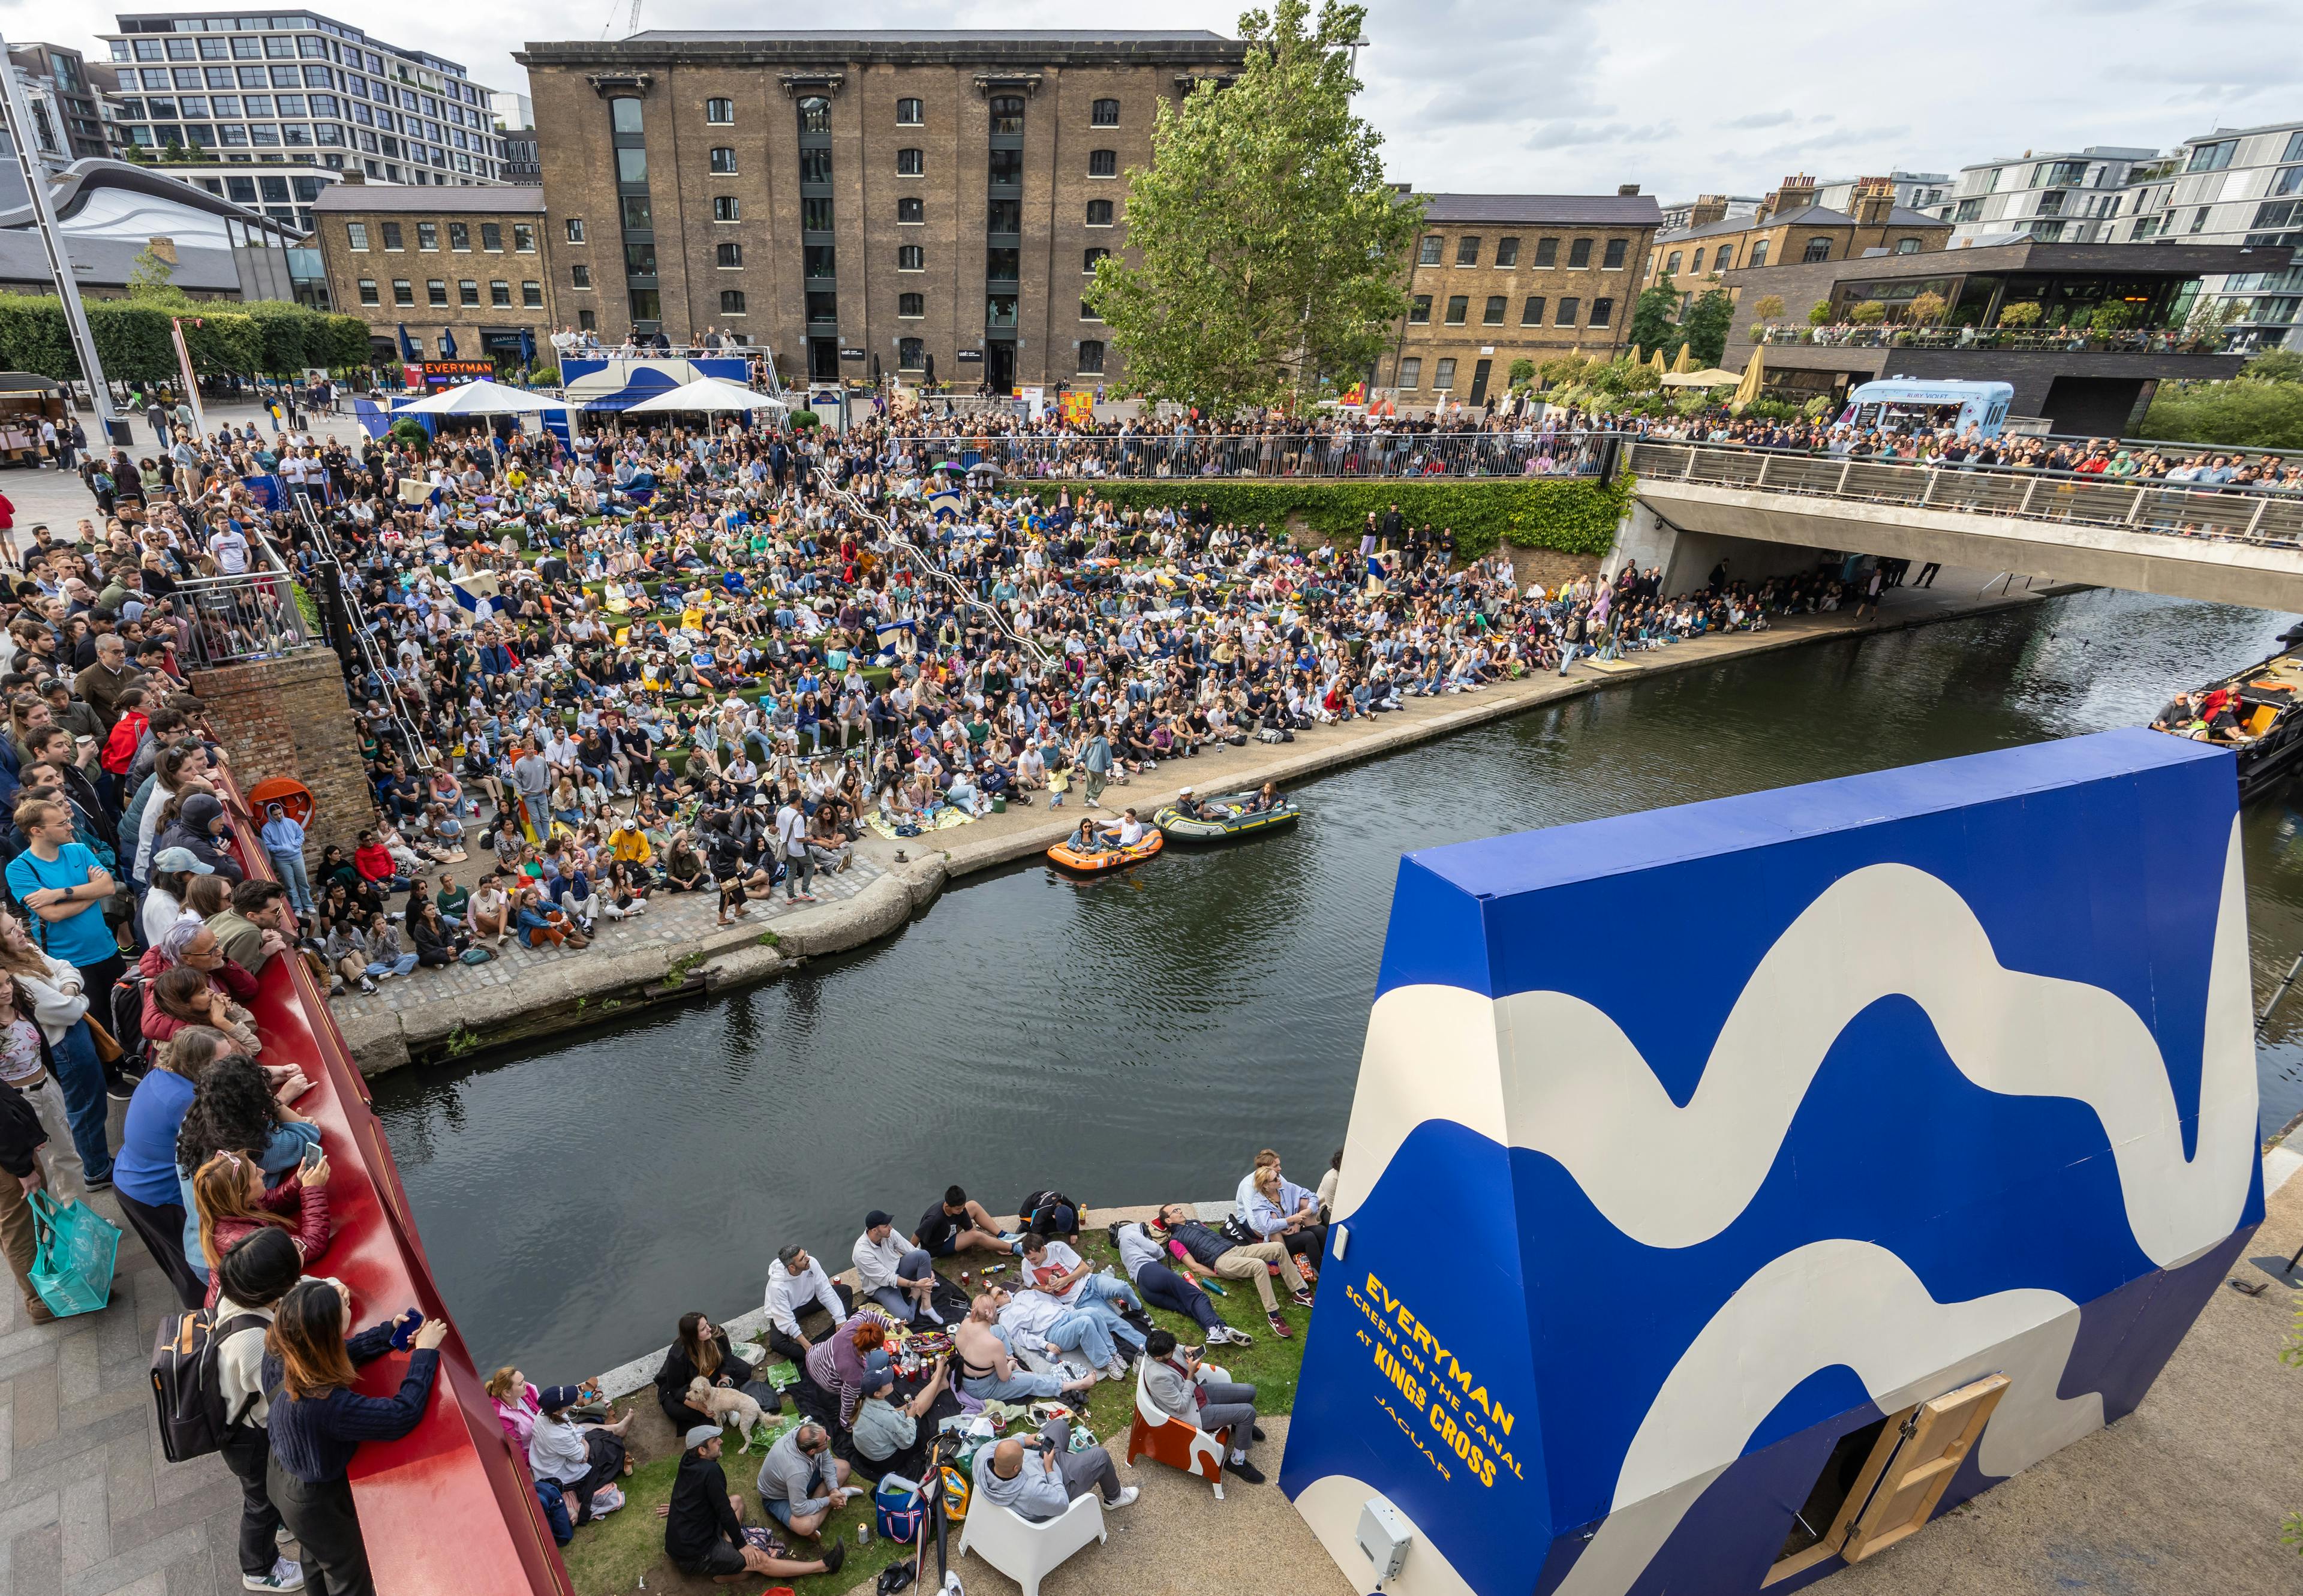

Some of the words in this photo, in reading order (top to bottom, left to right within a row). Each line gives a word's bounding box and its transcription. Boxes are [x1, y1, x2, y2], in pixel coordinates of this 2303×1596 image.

[426, 363, 492, 373] EVERYMAN
[1178, 822, 1213, 832] SEAHAWK
[446, 898, 465, 910] TOMMY
[1346, 1285, 1398, 1345] SCREEN
[1402, 1344, 1425, 1373] ON
[1430, 1371, 1460, 1411] THE
[1465, 1411, 1524, 1480] CANAL
[1366, 1273, 1514, 1435] EVERYMAN
[1357, 1330, 1372, 1346] AT
[1373, 1342, 1427, 1412] KINGS
[1430, 1403, 1497, 1487] CROSS
[1374, 1396, 1451, 1483] JAGUAR
